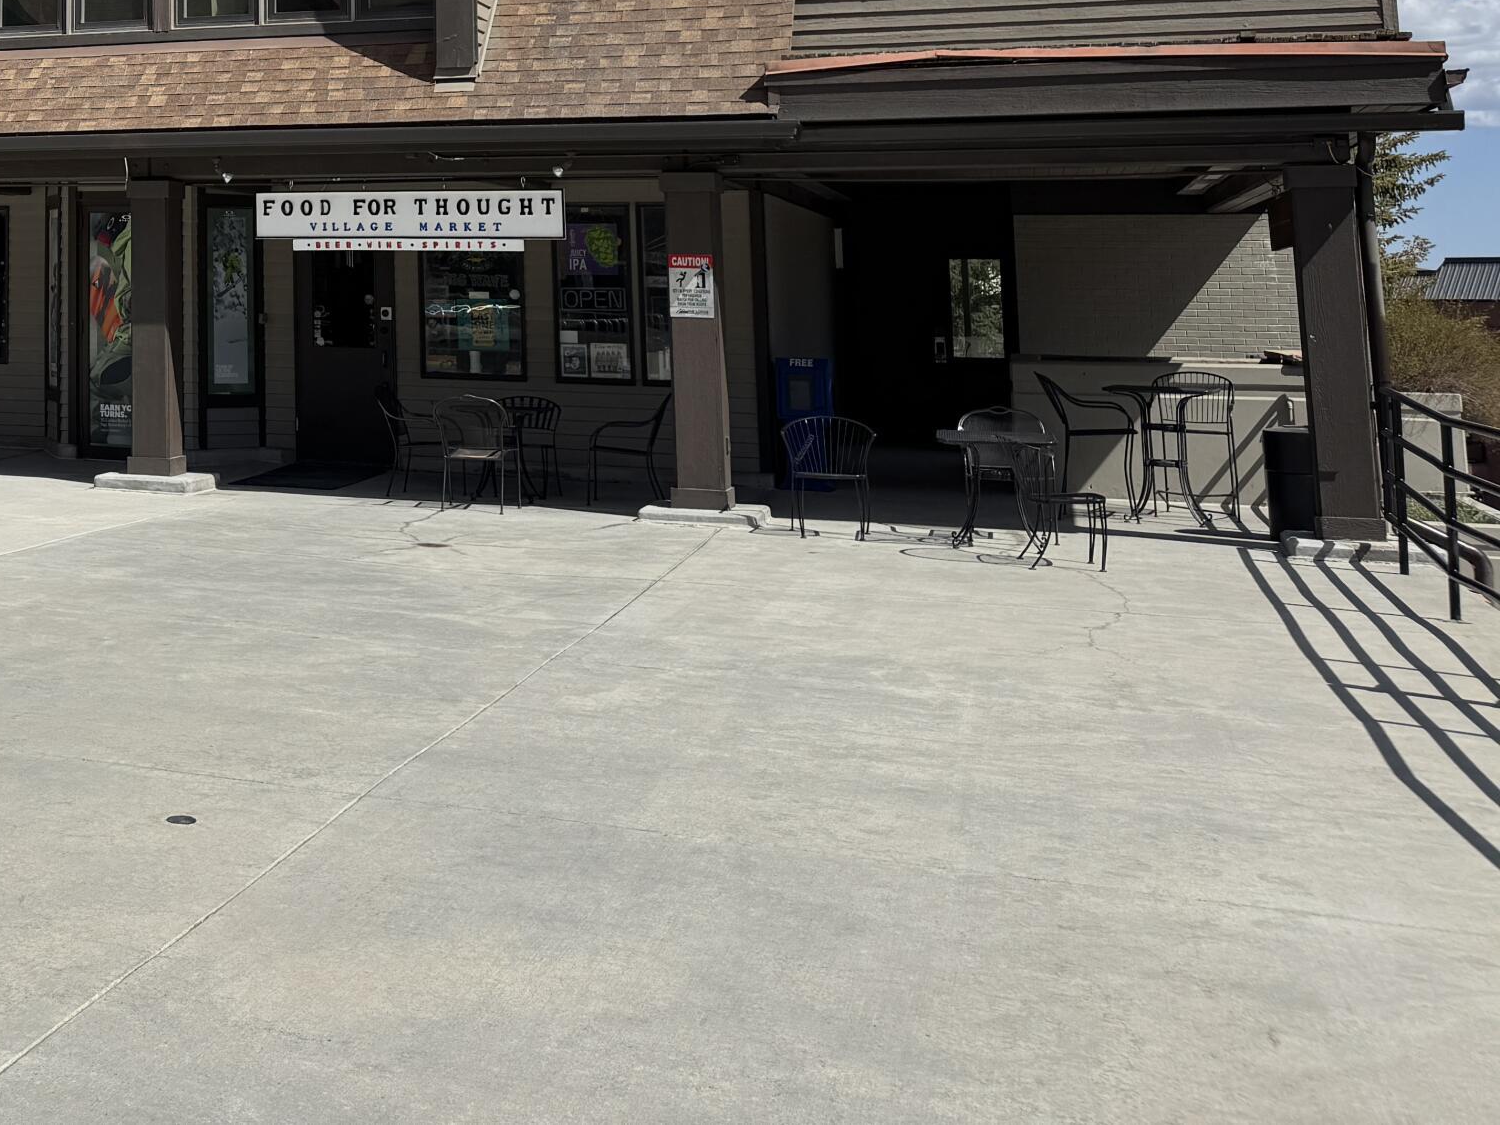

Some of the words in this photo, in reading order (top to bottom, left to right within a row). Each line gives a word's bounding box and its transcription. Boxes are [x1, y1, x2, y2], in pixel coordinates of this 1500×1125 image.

[262, 199, 332, 216] FOOD
[353, 199, 397, 216] FOR
[414, 197, 555, 216] THOUGHT
[310, 222, 393, 232] VILLAGE
[419, 221, 502, 232] MARKET
[315, 241, 352, 249] BEER
[367, 241, 403, 249] WINE
[422, 241, 498, 249] SPIRITS
[569, 258, 587, 271] IPA
[564, 290, 622, 308] OPEN
[789, 358, 814, 367] FREE
